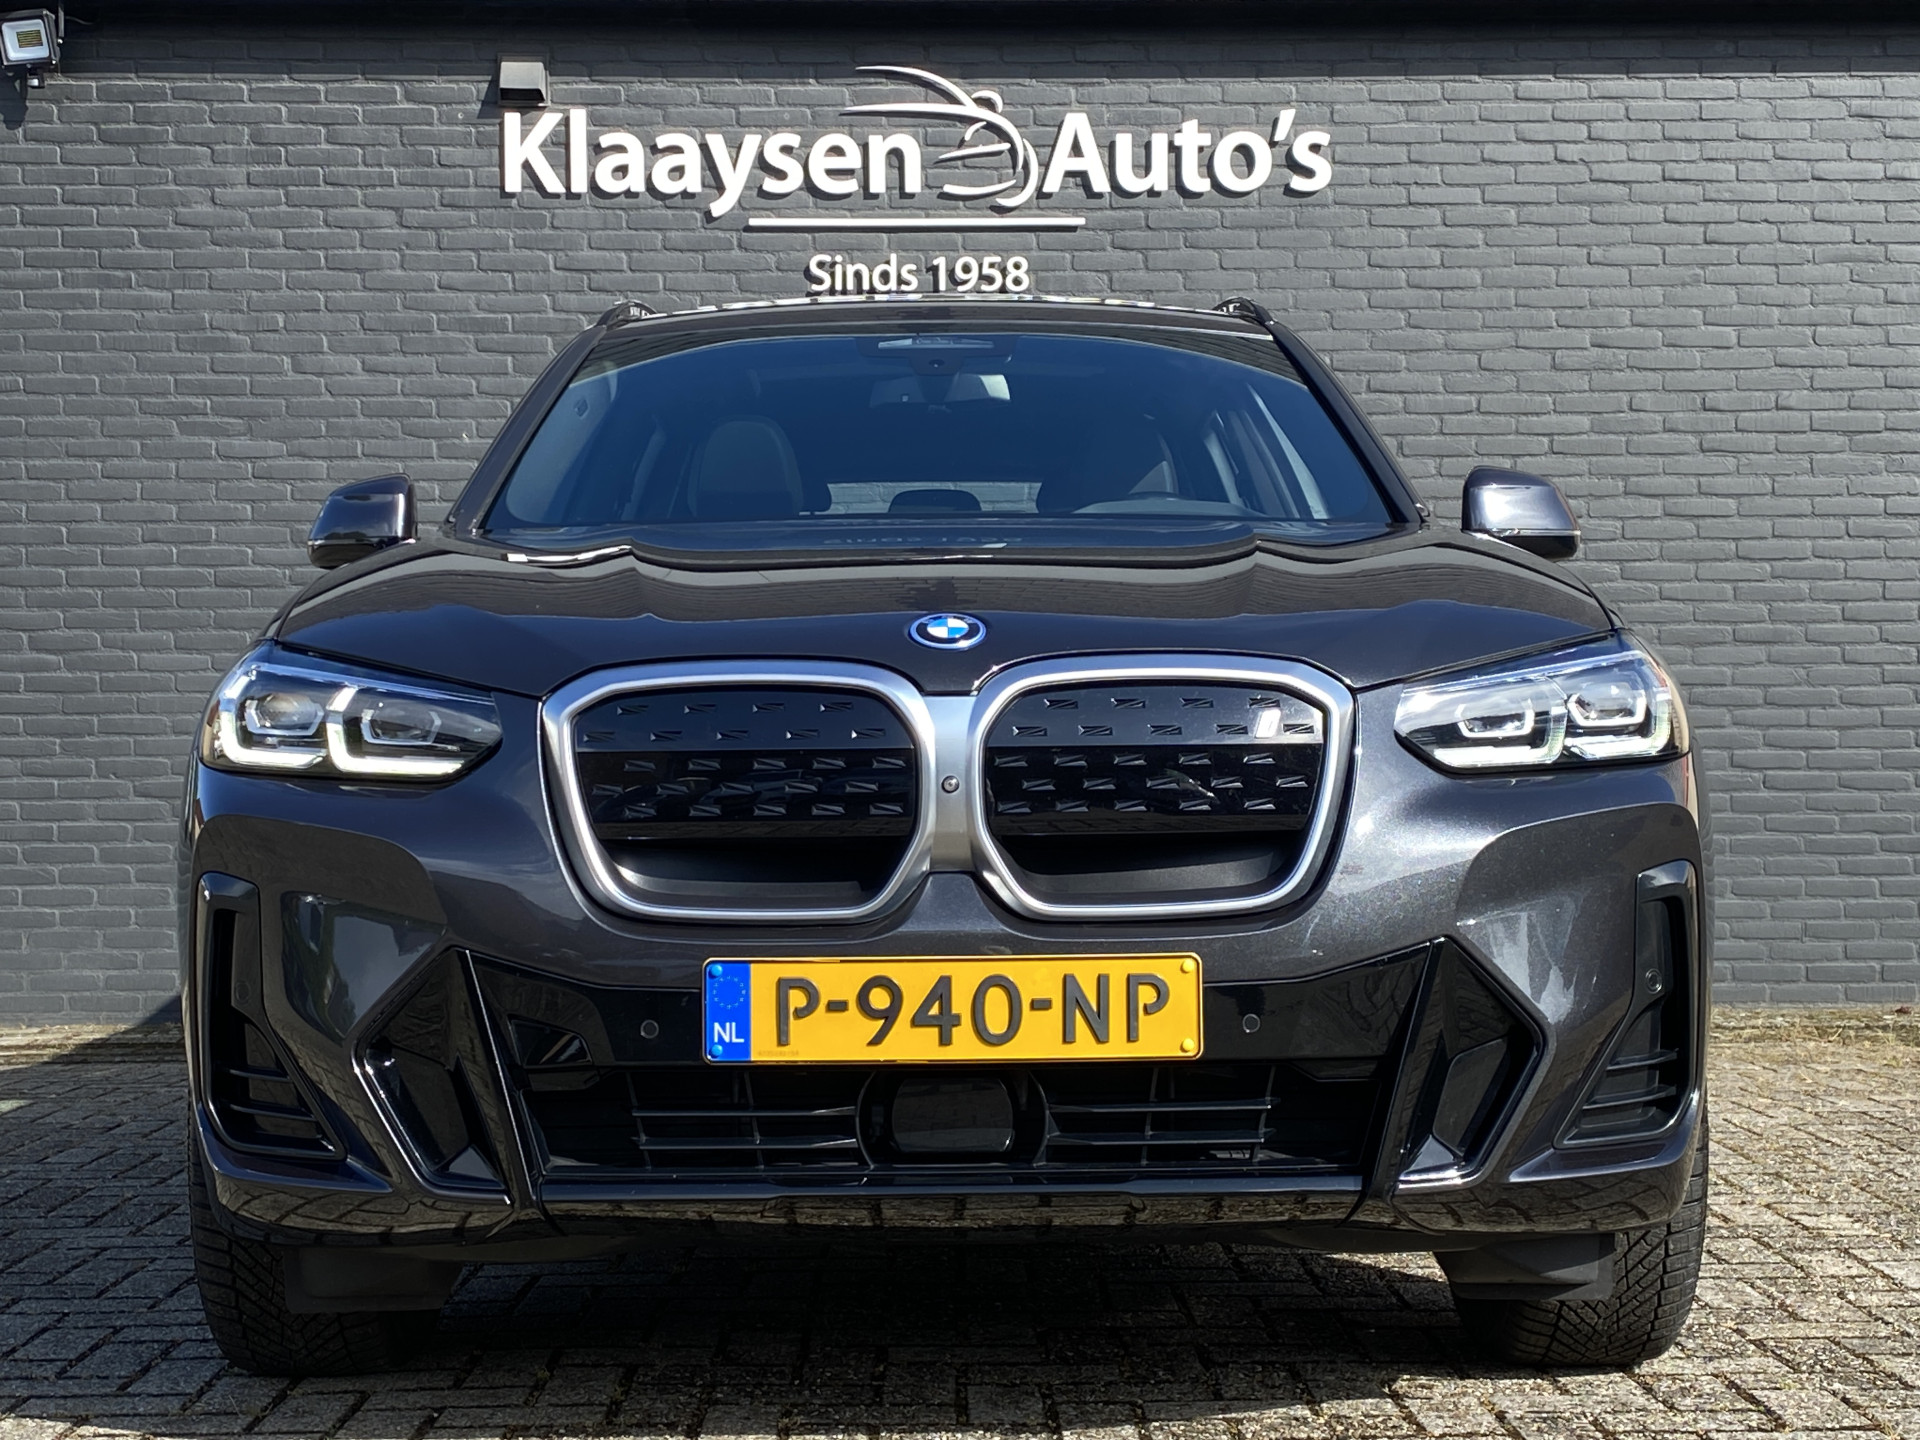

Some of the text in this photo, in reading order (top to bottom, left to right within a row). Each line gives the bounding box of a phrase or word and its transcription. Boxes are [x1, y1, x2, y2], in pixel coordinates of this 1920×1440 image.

[502, 108, 1333, 219] Klaaysen Auto's
[809, 253, 1030, 292] Sinds 1958
[713, 1022, 745, 1044] NL
[776, 973, 1170, 1047] P-940-NP
